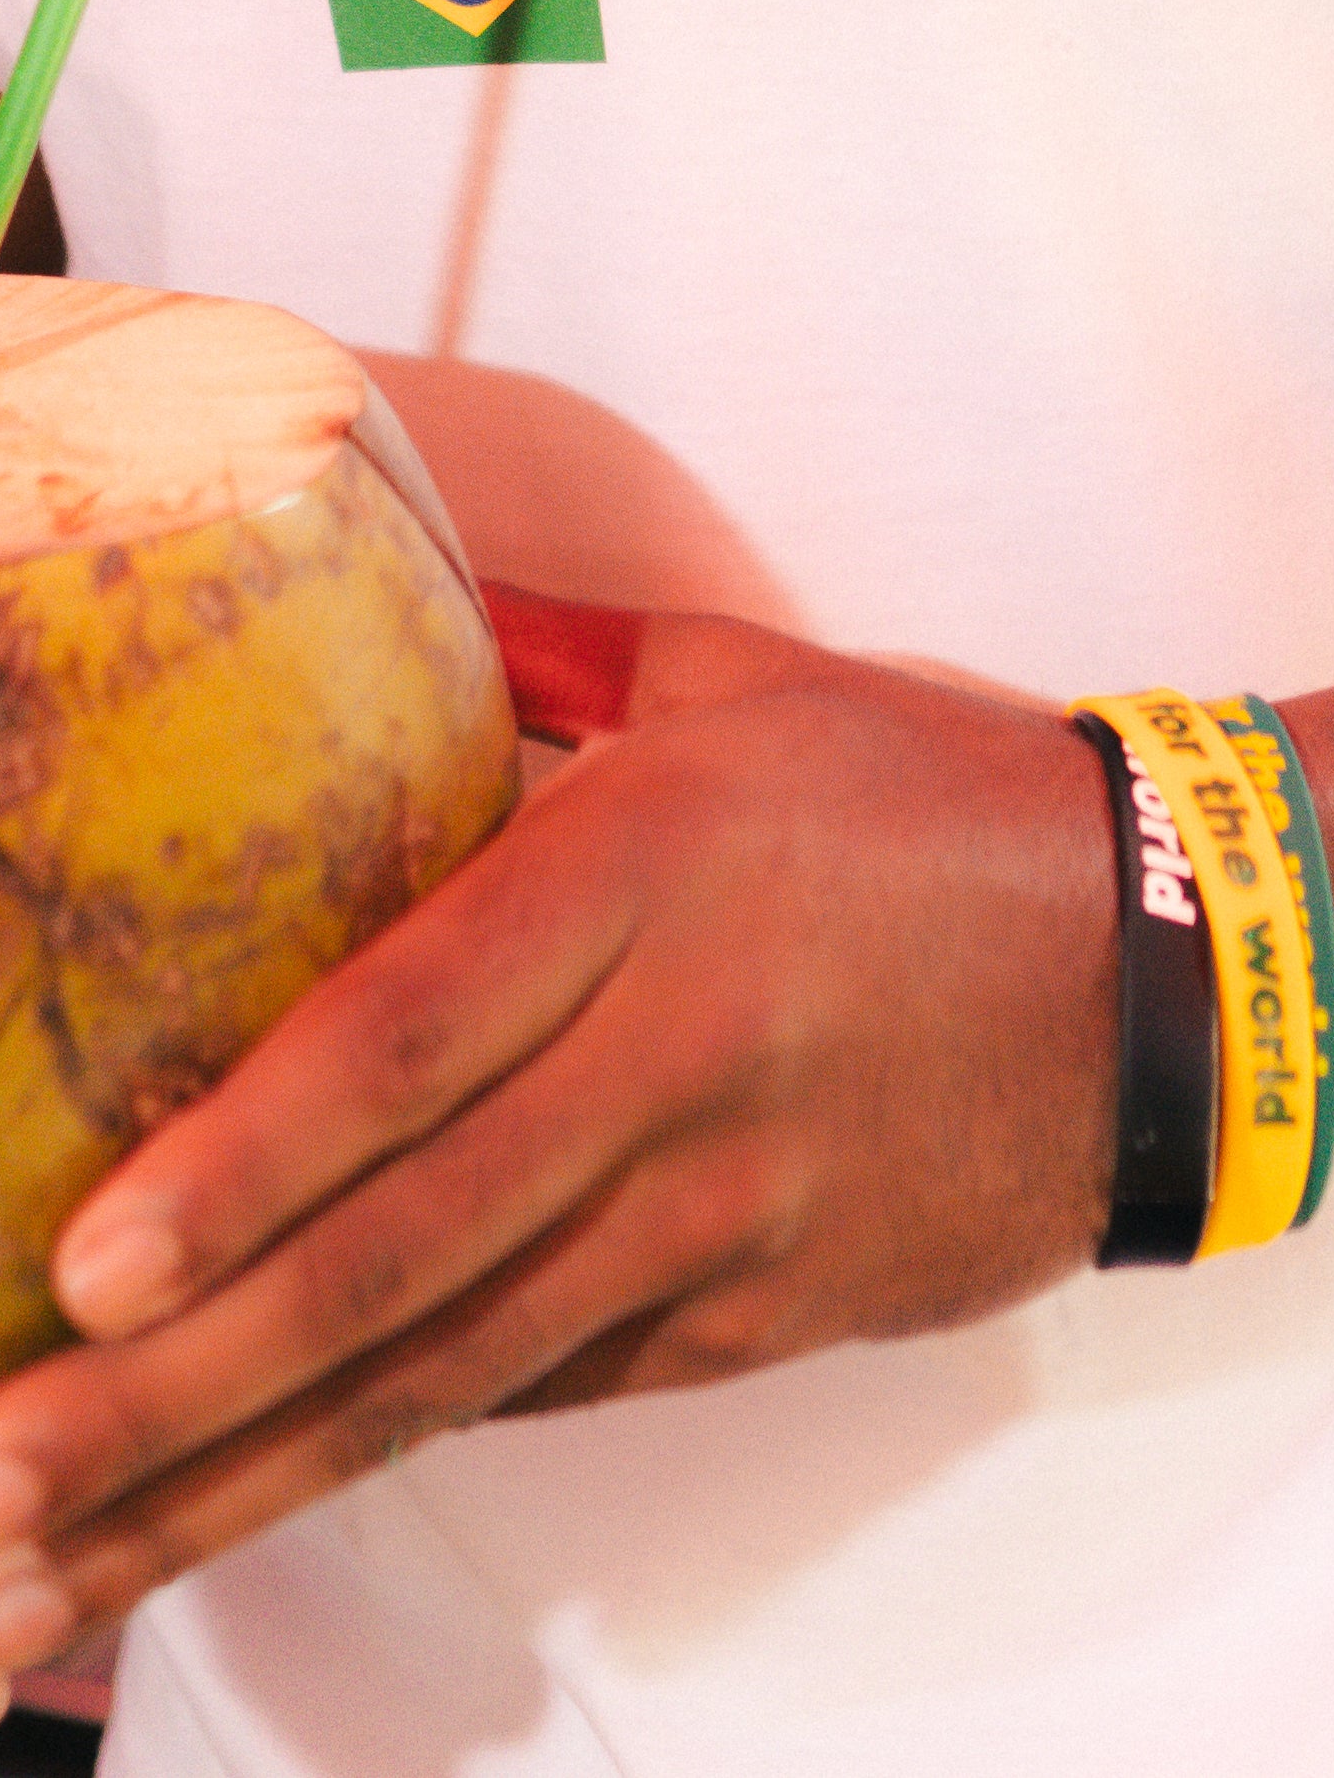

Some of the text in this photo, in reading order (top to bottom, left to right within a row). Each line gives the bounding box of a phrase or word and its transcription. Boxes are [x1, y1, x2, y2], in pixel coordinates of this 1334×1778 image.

[1136, 702, 1209, 760] for
[1191, 780, 1258, 887] the
[1242, 921, 1296, 1130] world
